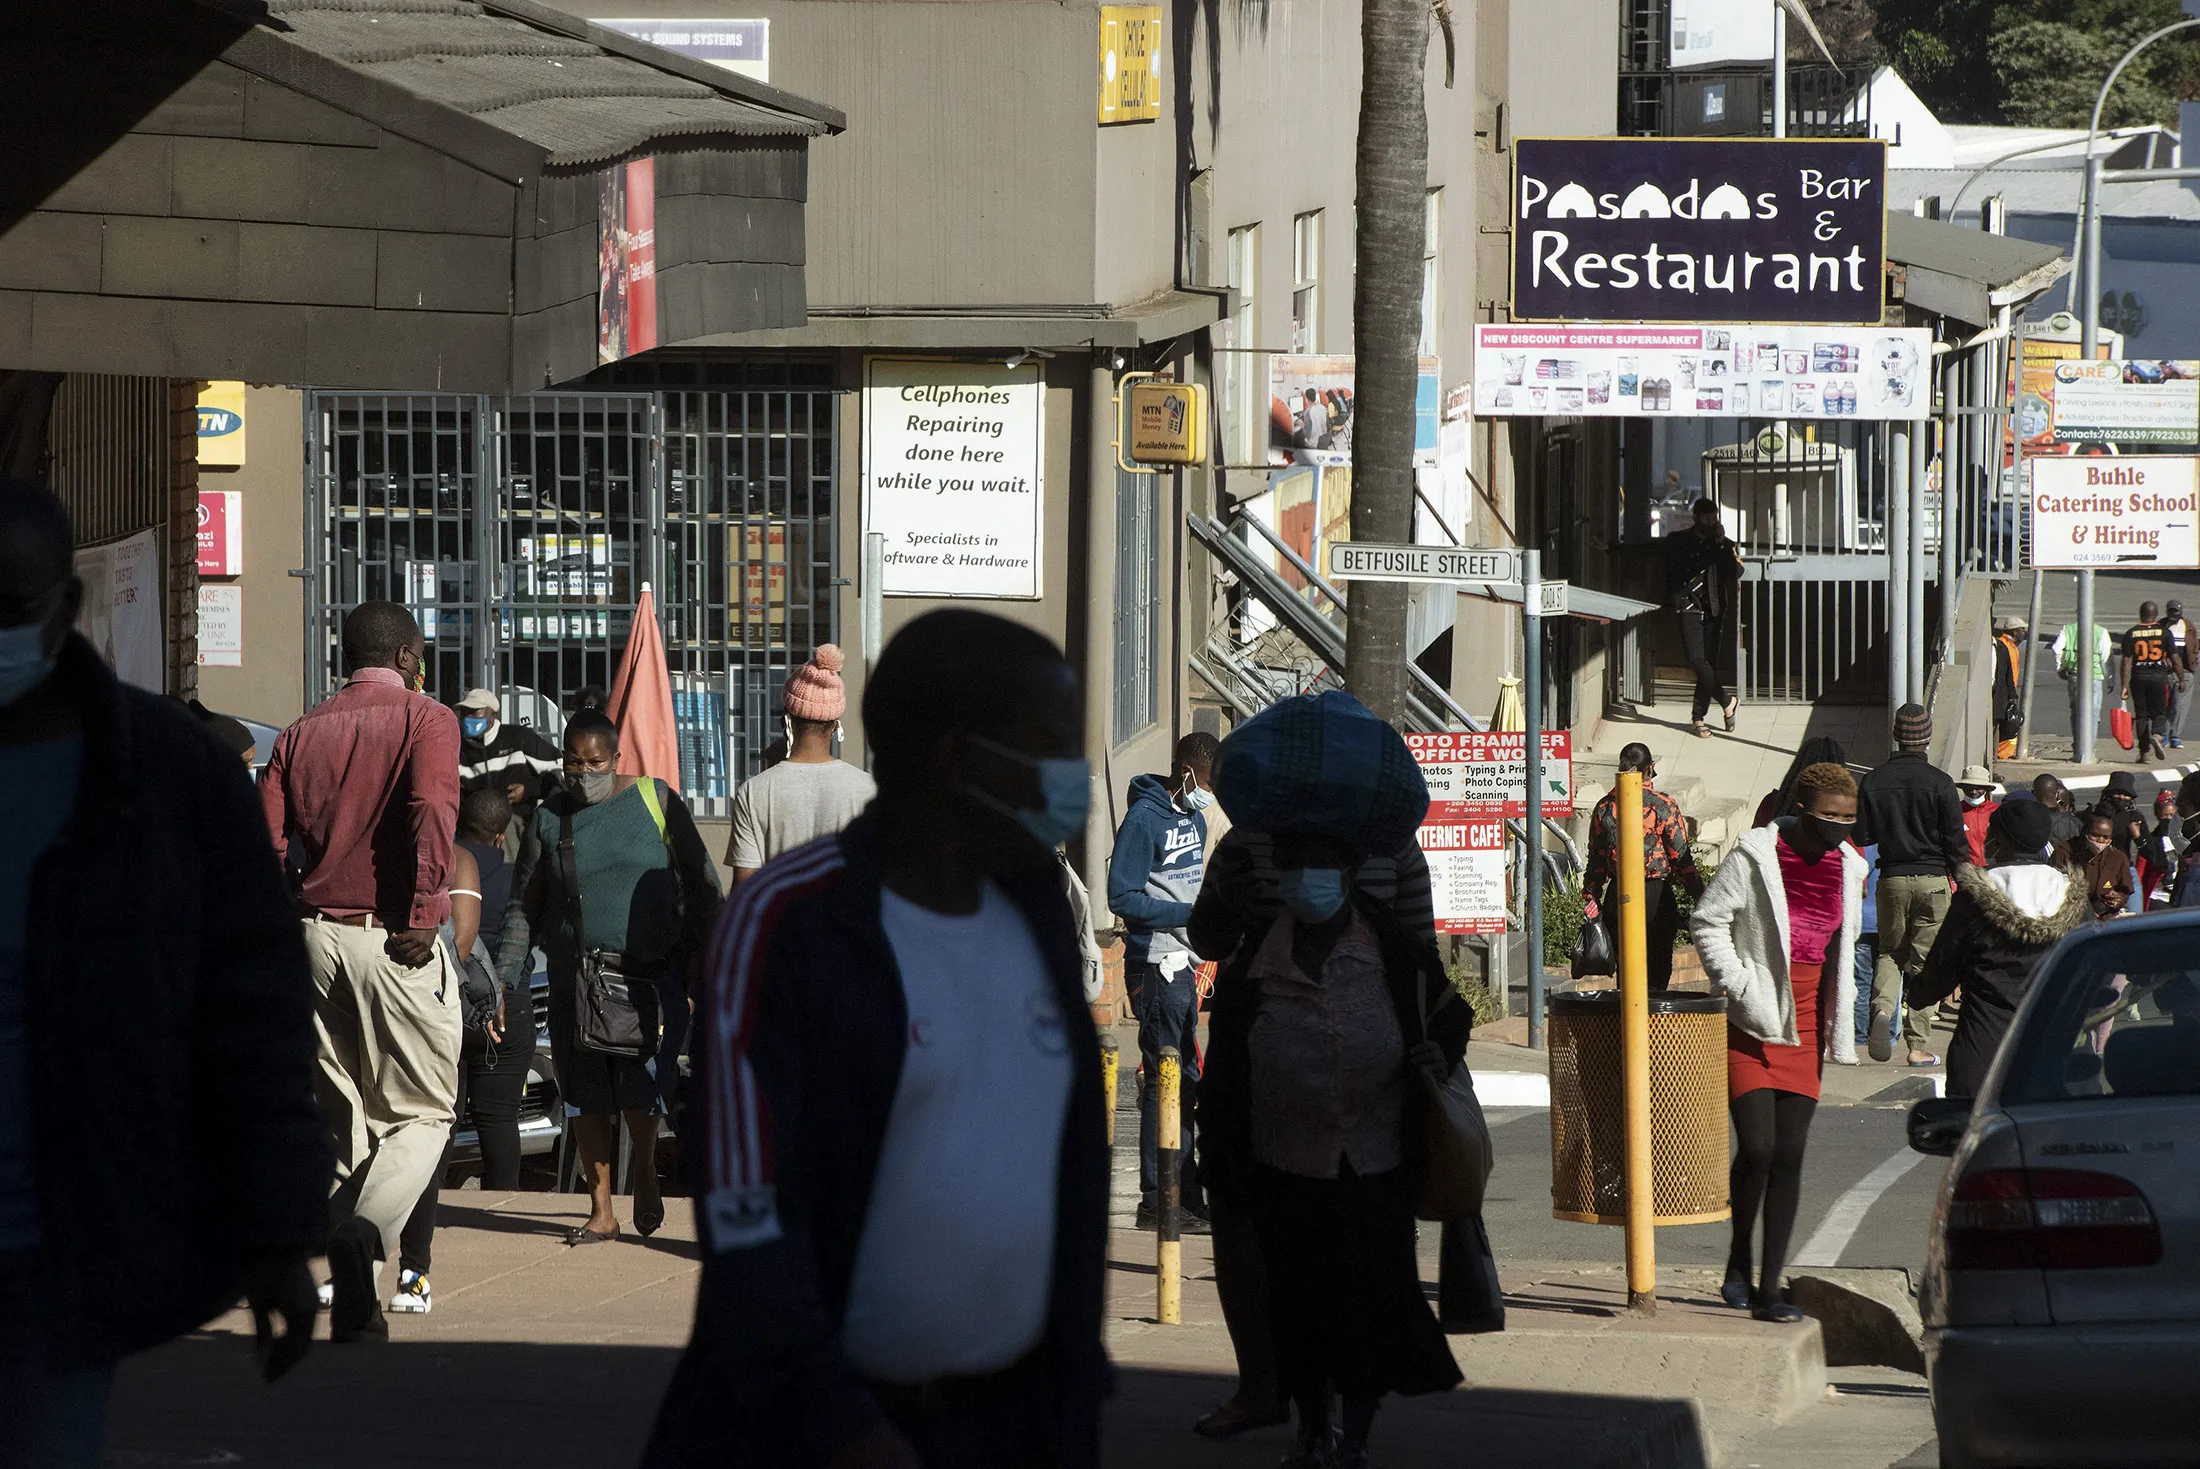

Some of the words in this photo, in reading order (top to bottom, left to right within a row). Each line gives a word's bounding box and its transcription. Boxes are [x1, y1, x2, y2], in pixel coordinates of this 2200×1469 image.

[652, 32, 691, 46] SOUND
[691, 33, 743, 46] SYSTEMS
[1799, 168, 1871, 200] Bar
[1813, 210, 1842, 242] &
[1531, 229, 1867, 294] Restaurant
[1483, 335, 1509, 345] NEW
[1510, 335, 1567, 345] DISCOUNT
[1569, 335, 1614, 345] CENTRE
[1616, 335, 1699, 346] SUPERMARKET
[2061, 347, 2081, 359] YOU
[2061, 365, 2107, 378] CARE
[900, 385, 1011, 407] Cellphones
[1141, 406, 1161, 415] MTN
[198, 413, 229, 431] TN
[906, 414, 1004, 438] Repairing
[1136, 441, 1169, 450] Available
[905, 443, 954, 461] done
[960, 445, 1005, 463] here
[2086, 467, 2145, 486] Buhle
[877, 472, 932, 490] while
[936, 478, 975, 495] you
[981, 476, 1030, 493] wait.
[2036, 493, 2123, 517] Catering
[2129, 493, 2197, 513] School
[906, 531, 981, 547] Specialists
[985, 534, 998, 546] in
[2071, 525, 2089, 545] &
[2095, 525, 2160, 549] Hiring
[884, 550, 938, 565] oftware
[942, 553, 955, 565] &
[959, 553, 1029, 568] Hardware
[1343, 551, 1430, 574] BETFUSILE
[1438, 555, 1499, 576] STREET
[2073, 554, 2089, 562] 624
[2091, 554, 2112, 562] 3569
[2134, 640, 2163, 661] 05
[1413, 749, 1485, 761] OFFICE
[1492, 748, 1556, 761] WOK
[1422, 767, 1453, 776] hotos
[1464, 765, 1496, 777] Typing
[1499, 765, 1506, 775] &
[1464, 777, 1493, 788] Photo
[1465, 790, 1509, 801] Scanning
[1417, 825, 1467, 848] NTERNET
[1470, 818, 1501, 847] CAFÉ
[1453, 855, 1474, 864] Typing
[1453, 864, 1474, 872] Faxing
[1454, 872, 1483, 880] Scanning
[1454, 880, 1484, 889] Company
[1475, 896, 1489, 905] Tags
[1479, 903, 1502, 912] Badges
